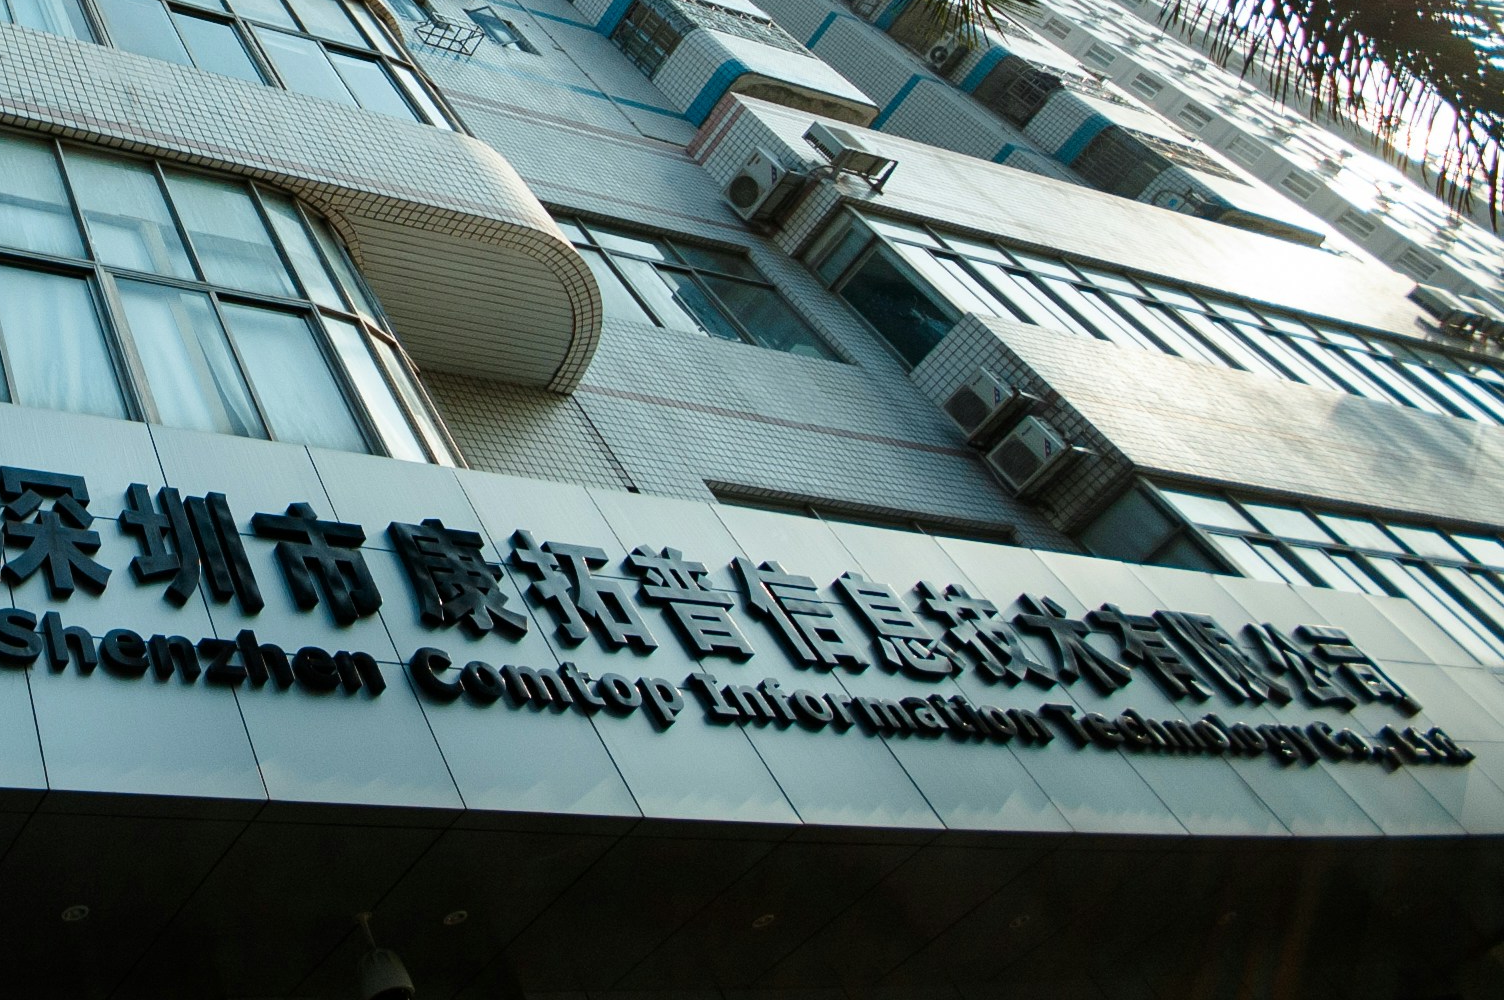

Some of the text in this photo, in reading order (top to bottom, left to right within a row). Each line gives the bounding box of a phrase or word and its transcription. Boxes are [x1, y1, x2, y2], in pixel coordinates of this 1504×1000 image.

[409, 646, 685, 731] Comtop
[686, 671, 1054, 747] Information
[1039, 702, 1320, 767] Technology
